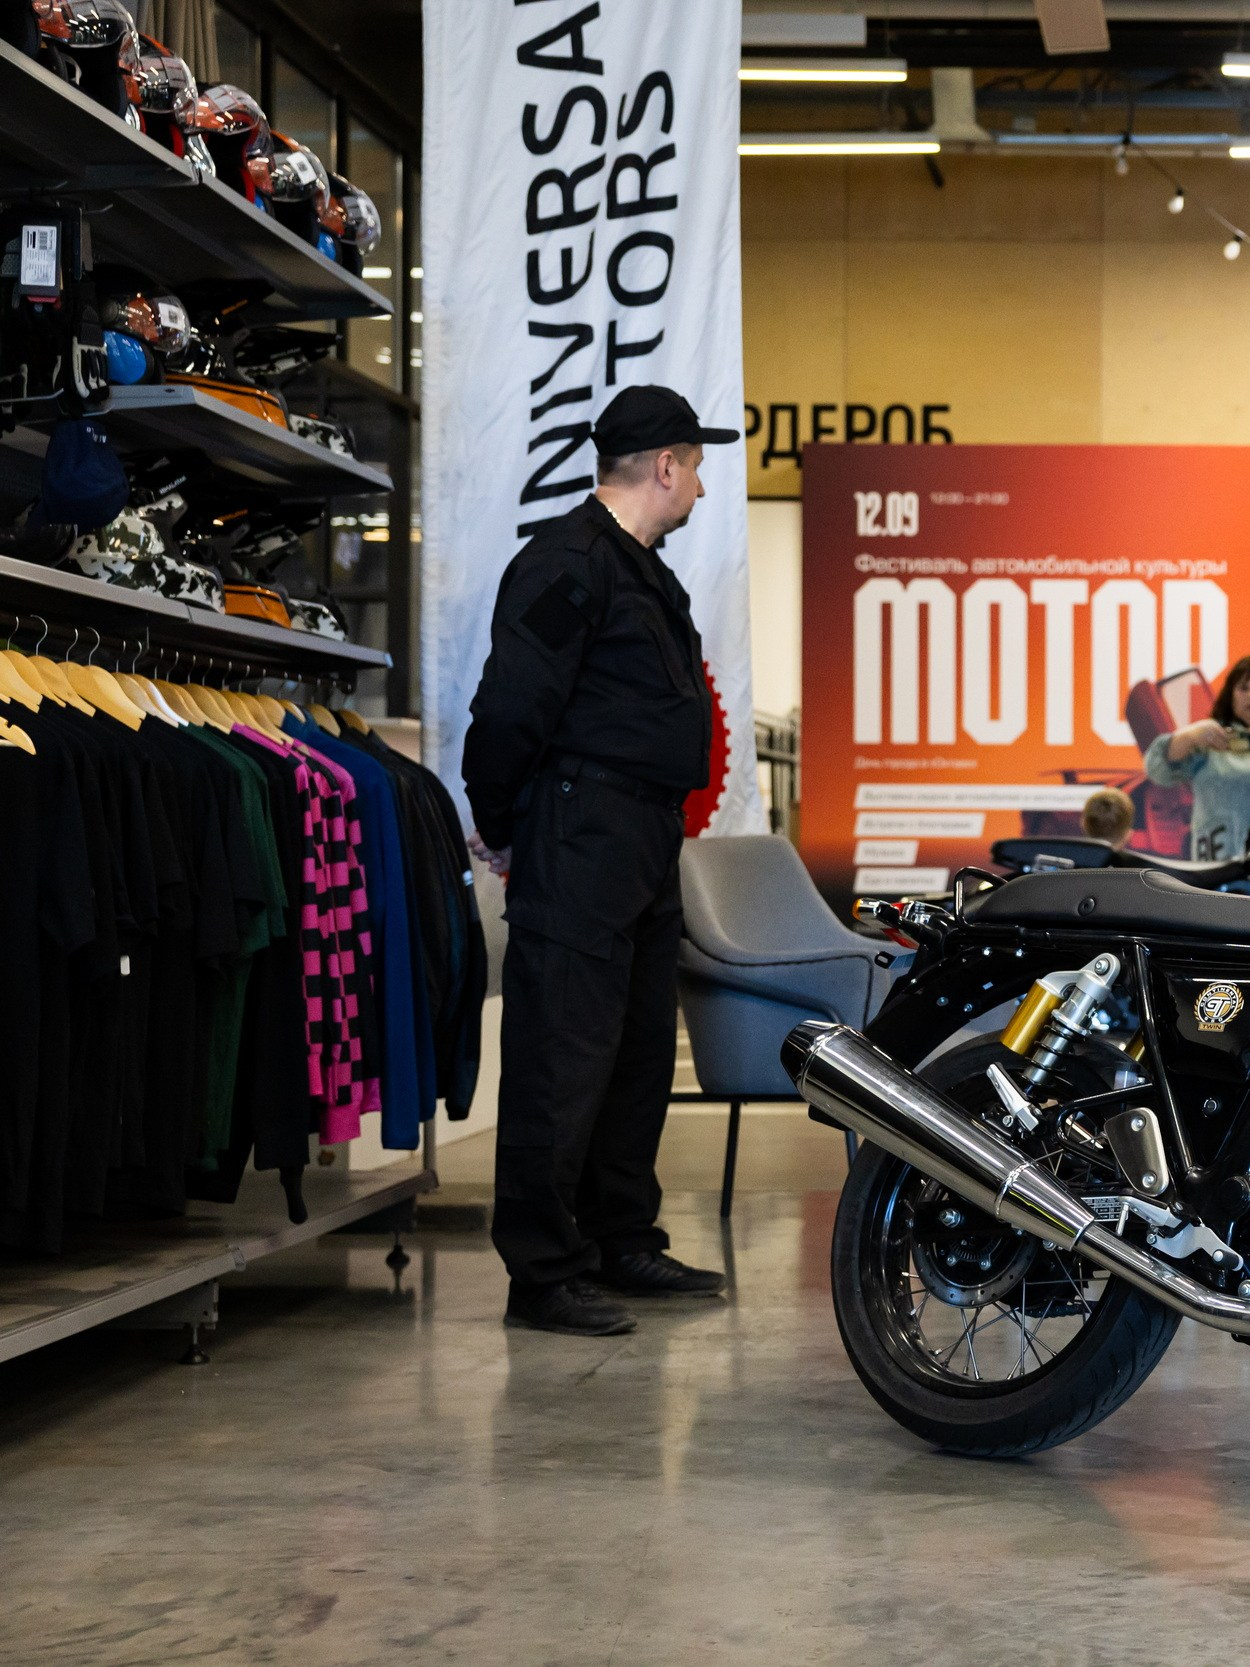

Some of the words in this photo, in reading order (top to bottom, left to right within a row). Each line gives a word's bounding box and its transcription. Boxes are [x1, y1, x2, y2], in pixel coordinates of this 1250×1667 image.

[514, 0, 608, 541] NIVERSA
[854, 491, 919, 537] 12.09
[854, 554, 969, 573] Фестиваль
[971, 555, 1131, 574] автомобильной
[1133, 559, 1228, 579] культуры
[1201, 987, 1238, 1009] CONTINENTAL
[1205, 997, 1231, 1018] GT
